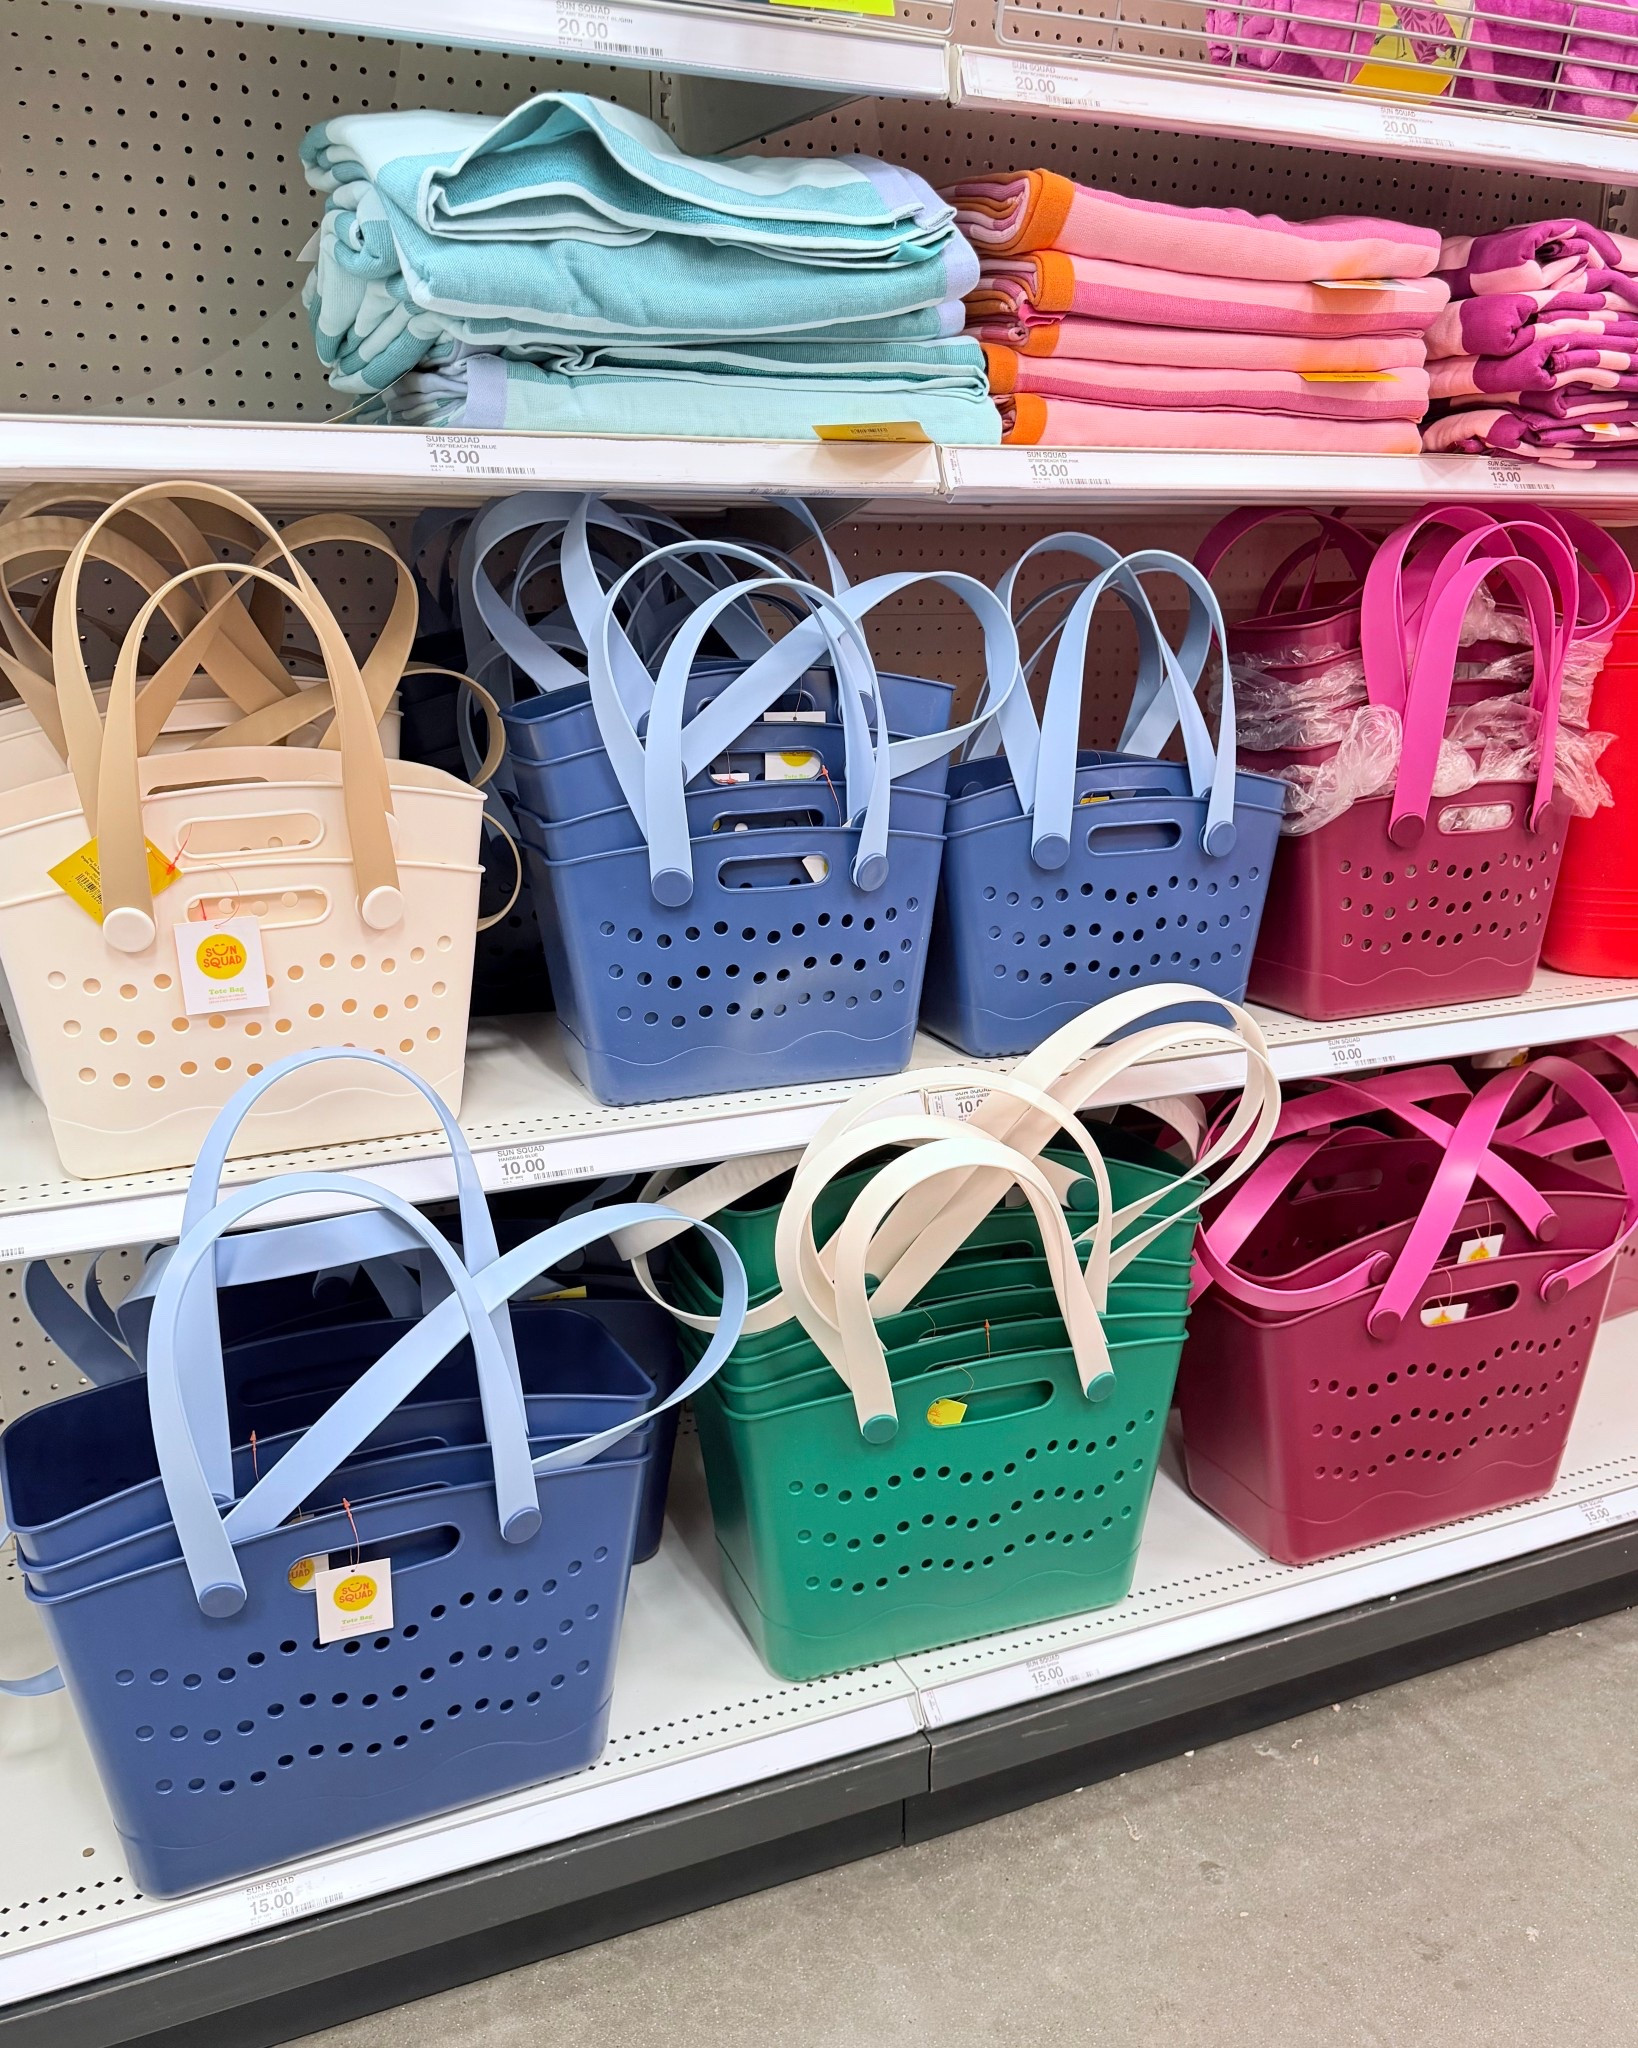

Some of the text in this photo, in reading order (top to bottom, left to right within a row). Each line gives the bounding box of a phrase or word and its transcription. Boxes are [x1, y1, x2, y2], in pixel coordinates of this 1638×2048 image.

[556, 1, 576, 11] SUN
[578, 4, 610, 15] SQUAD
[558, 18, 608, 39] 20.00
[1030, 63, 1056, 73] SQUAD
[1016, 76, 1055, 94] 20.00
[1383, 120, 1416, 135] 20.00
[430, 450, 480, 464] 13.00
[1031, 464, 1068, 476] 13.00
[1491, 472, 1521, 482] 13.00
[206, 944, 237, 957] SUN
[203, 955, 242, 968] SQUAD
[1332, 1048, 1362, 1062] 10.00
[516, 1145, 545, 1155] SQUAD
[501, 1158, 545, 1176] 10.00
[1585, 1508, 1610, 1521] 15.00
[342, 1582, 370, 1594] SUN
[339, 1590, 373, 1603] SQUAD
[1032, 1666, 1063, 1684] 15.00
[246, 1876, 294, 1896] SUN SQUAD
[250, 1891, 294, 1915] 15.00
